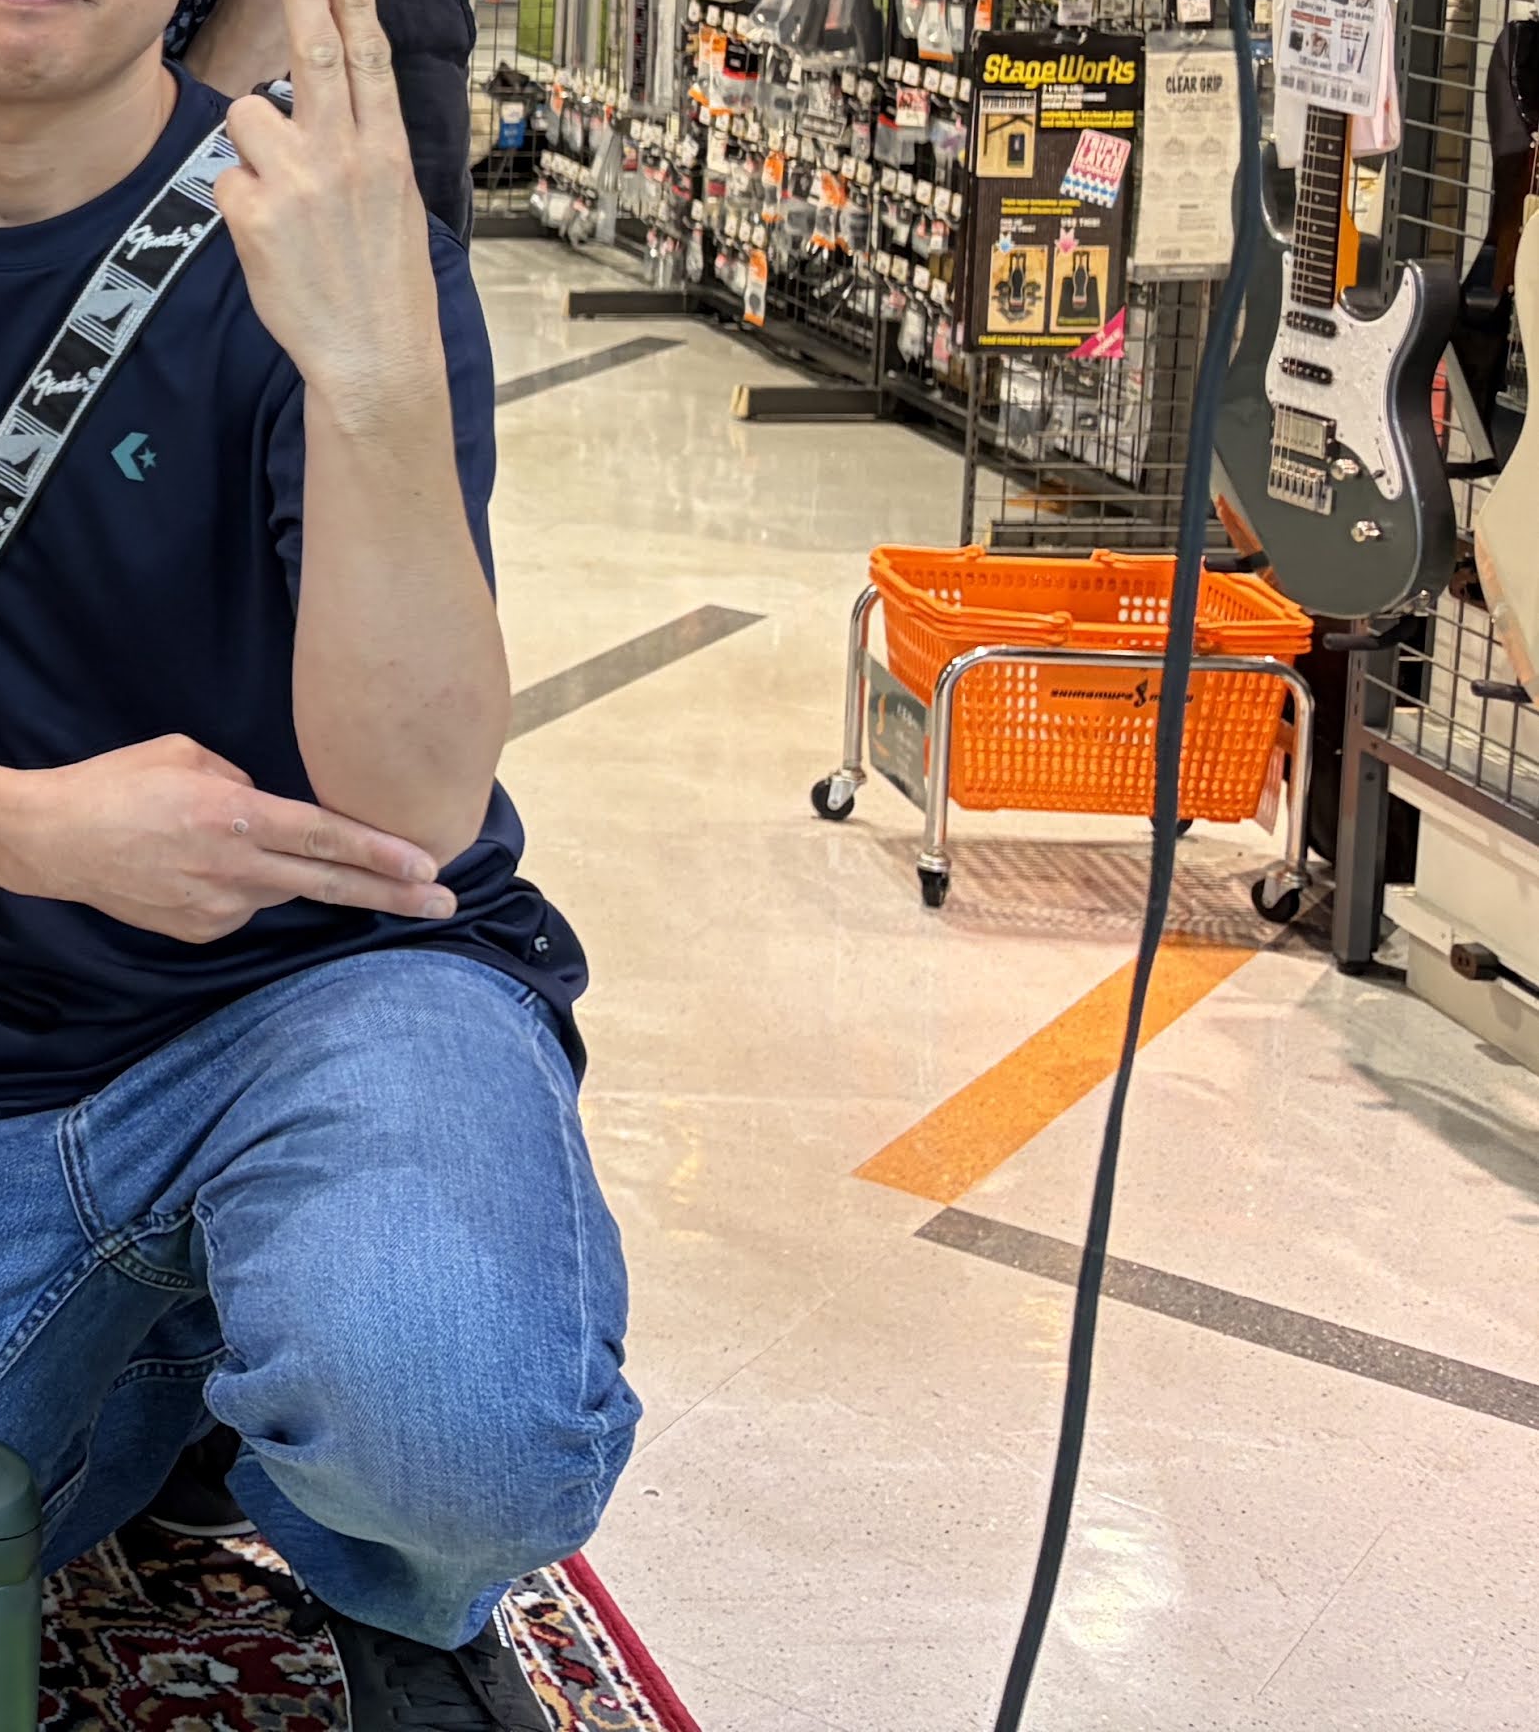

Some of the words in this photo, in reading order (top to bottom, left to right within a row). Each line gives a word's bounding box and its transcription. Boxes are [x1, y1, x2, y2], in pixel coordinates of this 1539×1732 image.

[983, 53, 1136, 90] StageWorks
[1166, 76, 1197, 94] CLEAR
[1200, 76, 1223, 93] GRIP
